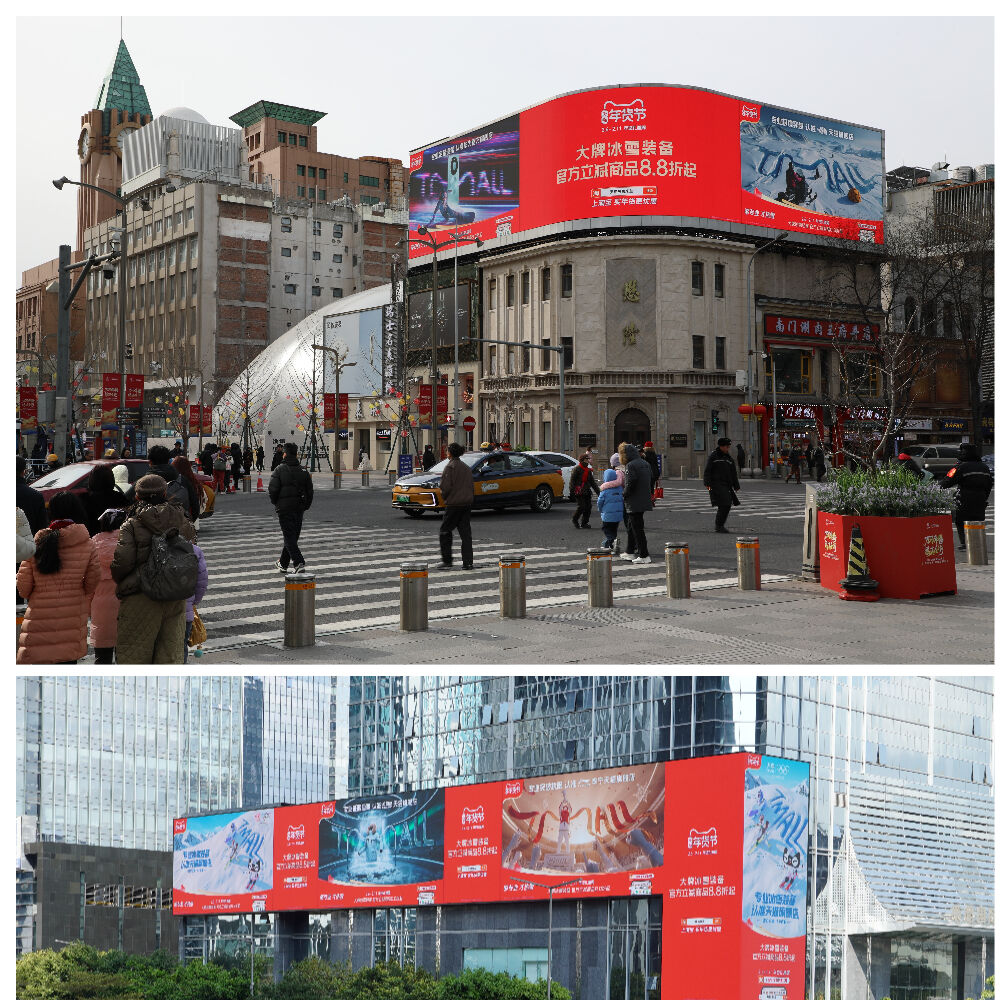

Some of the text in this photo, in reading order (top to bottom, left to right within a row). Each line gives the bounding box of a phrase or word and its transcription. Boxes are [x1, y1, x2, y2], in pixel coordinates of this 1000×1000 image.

[576, 140, 674, 161] 大牌冰雪装备
[556, 159, 697, 184] 官方立减商品8.8折起
[680, 874, 725, 887] 大牌冰雪装备
[668, 886, 736, 899] 官方立减商品8.8折起
